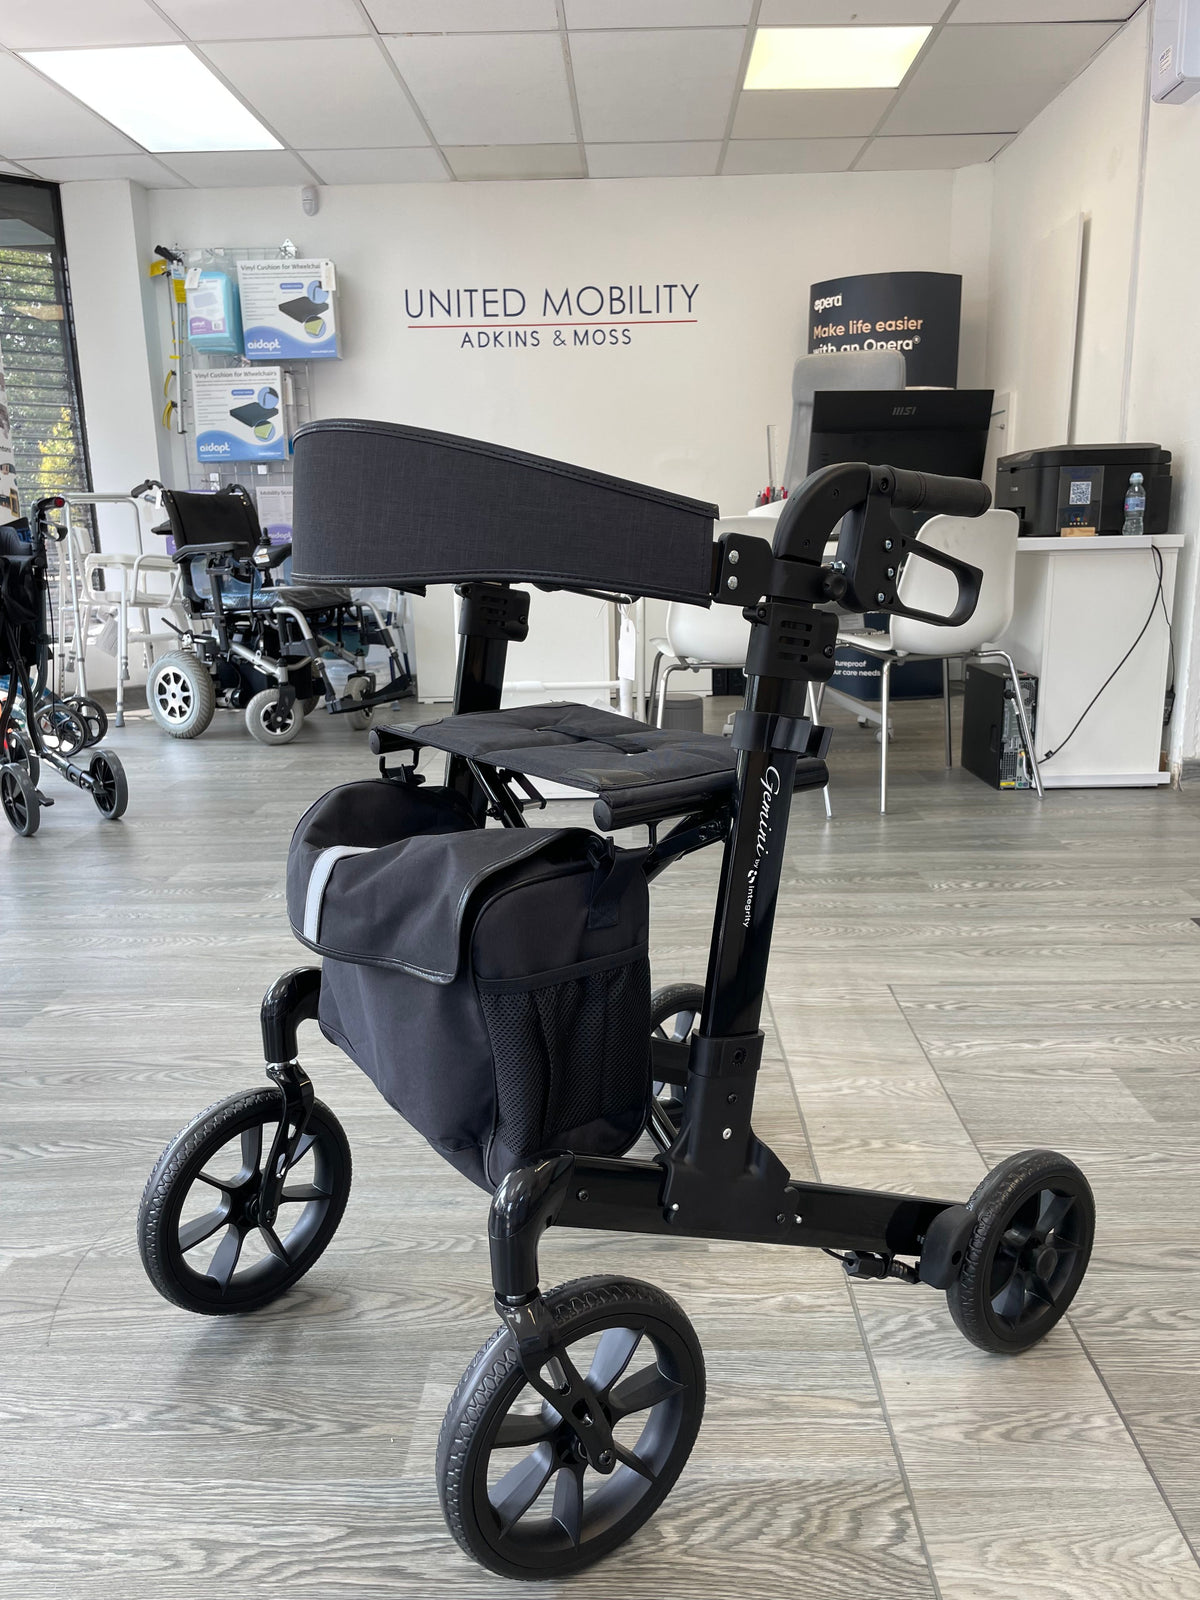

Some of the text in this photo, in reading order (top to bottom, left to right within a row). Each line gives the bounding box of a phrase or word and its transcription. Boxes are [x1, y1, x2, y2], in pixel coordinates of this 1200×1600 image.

[240, 263, 256, 272] Vinyl
[256, 263, 281, 271] Cushion
[405, 284, 699, 318] UNITED MOBILITY
[813, 316, 923, 339] Make life easier
[460, 328, 632, 348] ADKINS & MOSS
[247, 338, 281, 351] aidapt
[840, 343, 860, 352] an
[194, 372, 209, 380] Vinyl
[199, 441, 231, 453] aidapt
[834, 660, 867, 668] tureproof
[858, 669, 881, 677] needs
[757, 765, 781, 857] Gemini
[742, 885, 756, 928] Integrity
